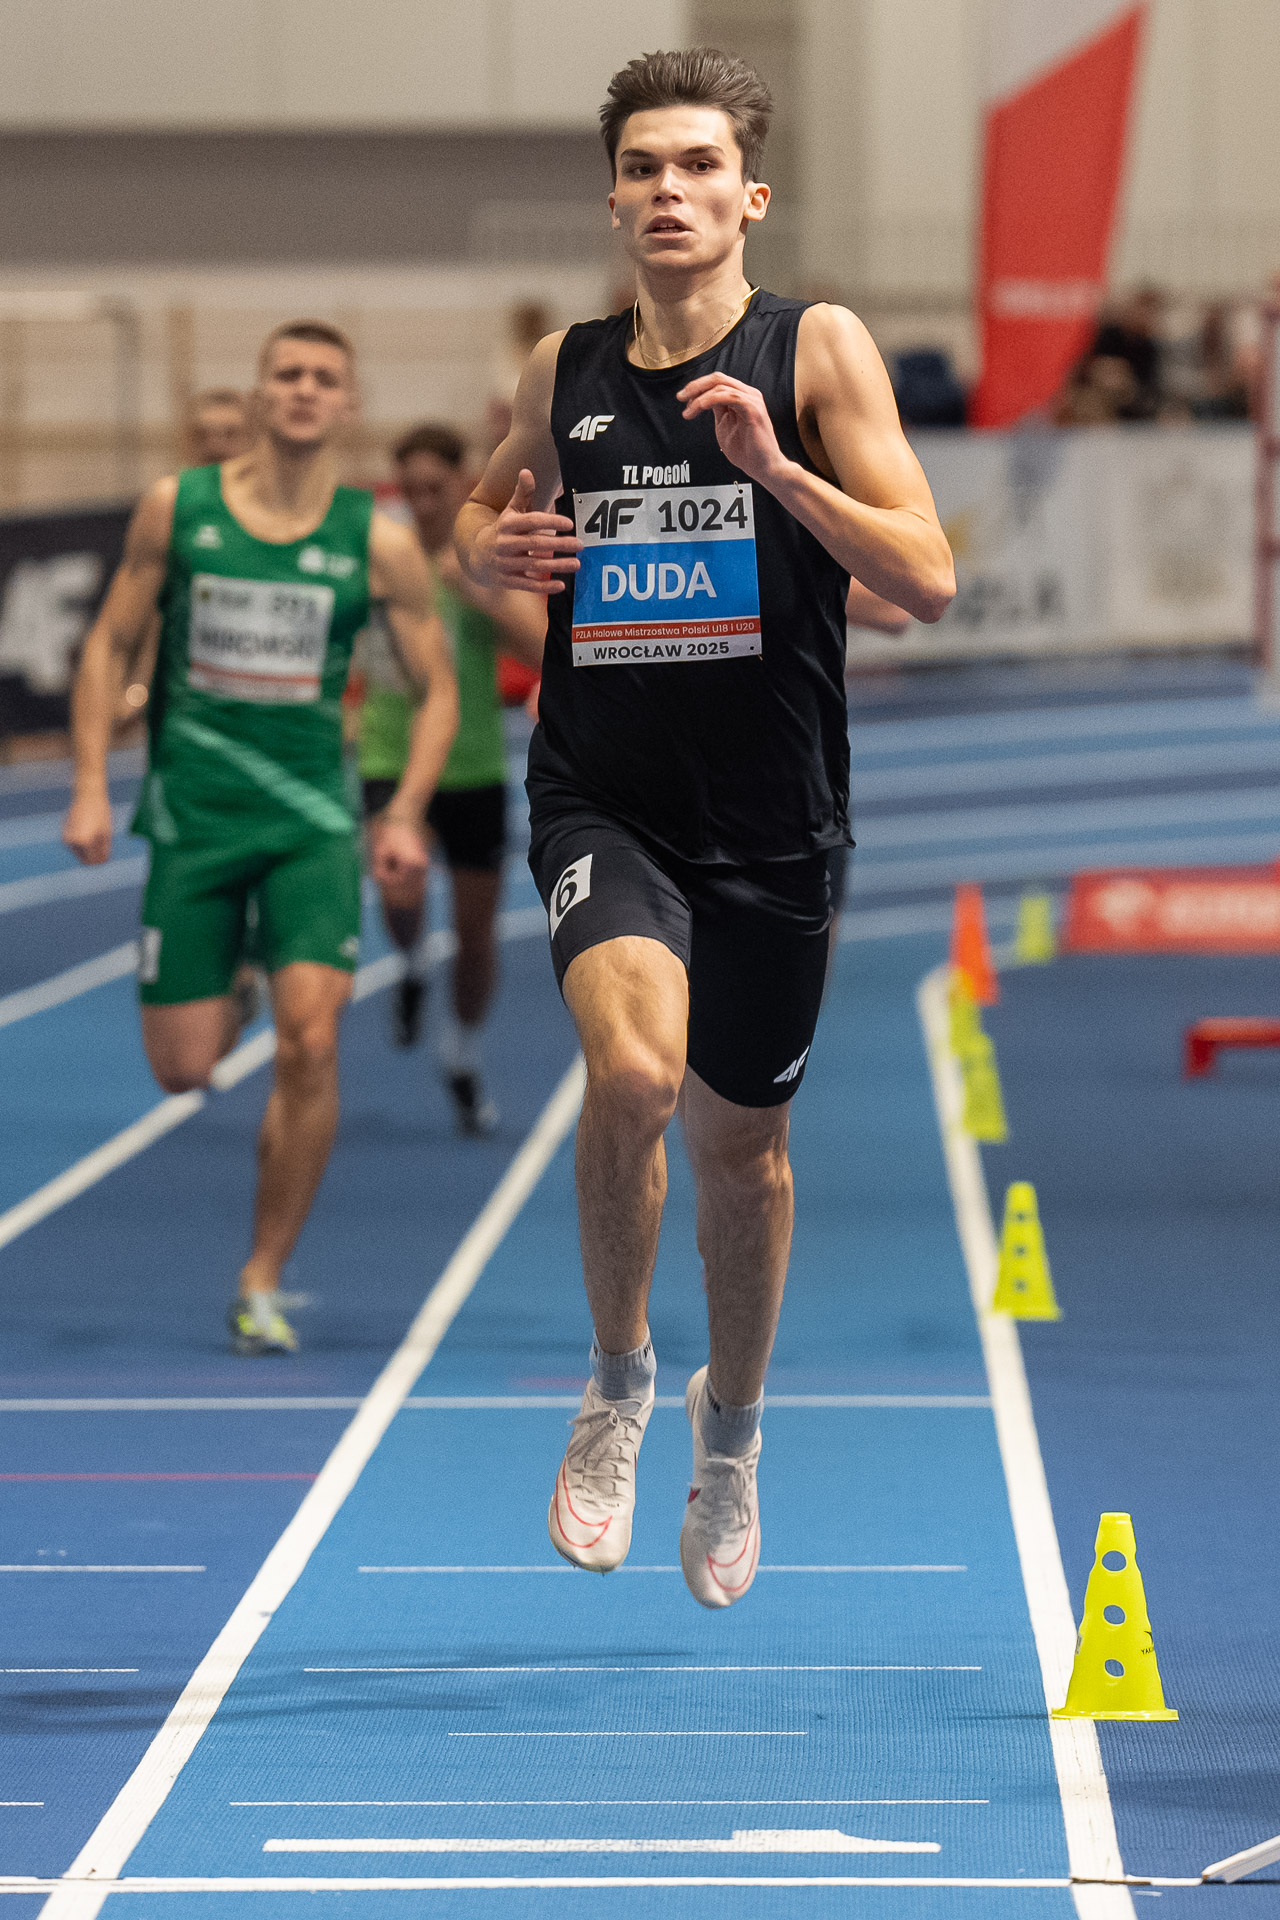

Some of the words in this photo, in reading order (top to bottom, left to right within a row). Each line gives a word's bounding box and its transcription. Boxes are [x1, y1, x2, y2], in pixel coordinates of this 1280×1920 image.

[569, 414, 615, 441] 4F
[622, 465, 639, 485] TL
[642, 460, 691, 486] POGOŃ
[584, 498, 644, 539] 4F
[658, 496, 748, 533] 1024
[601, 561, 717, 602] DUDA
[575, 630, 591, 640] PZLA
[592, 628, 623, 638] Halowe
[624, 626, 680, 637] Mistrzostwa
[682, 624, 710, 635] Polski
[712, 623, 729, 633] U18
[735, 621, 755, 632] U20
[593, 644, 682, 660] WROCŁAW
[687, 641, 730, 657] 2025
[556, 868, 578, 918] 6
[773, 1045, 810, 1084] 4F
